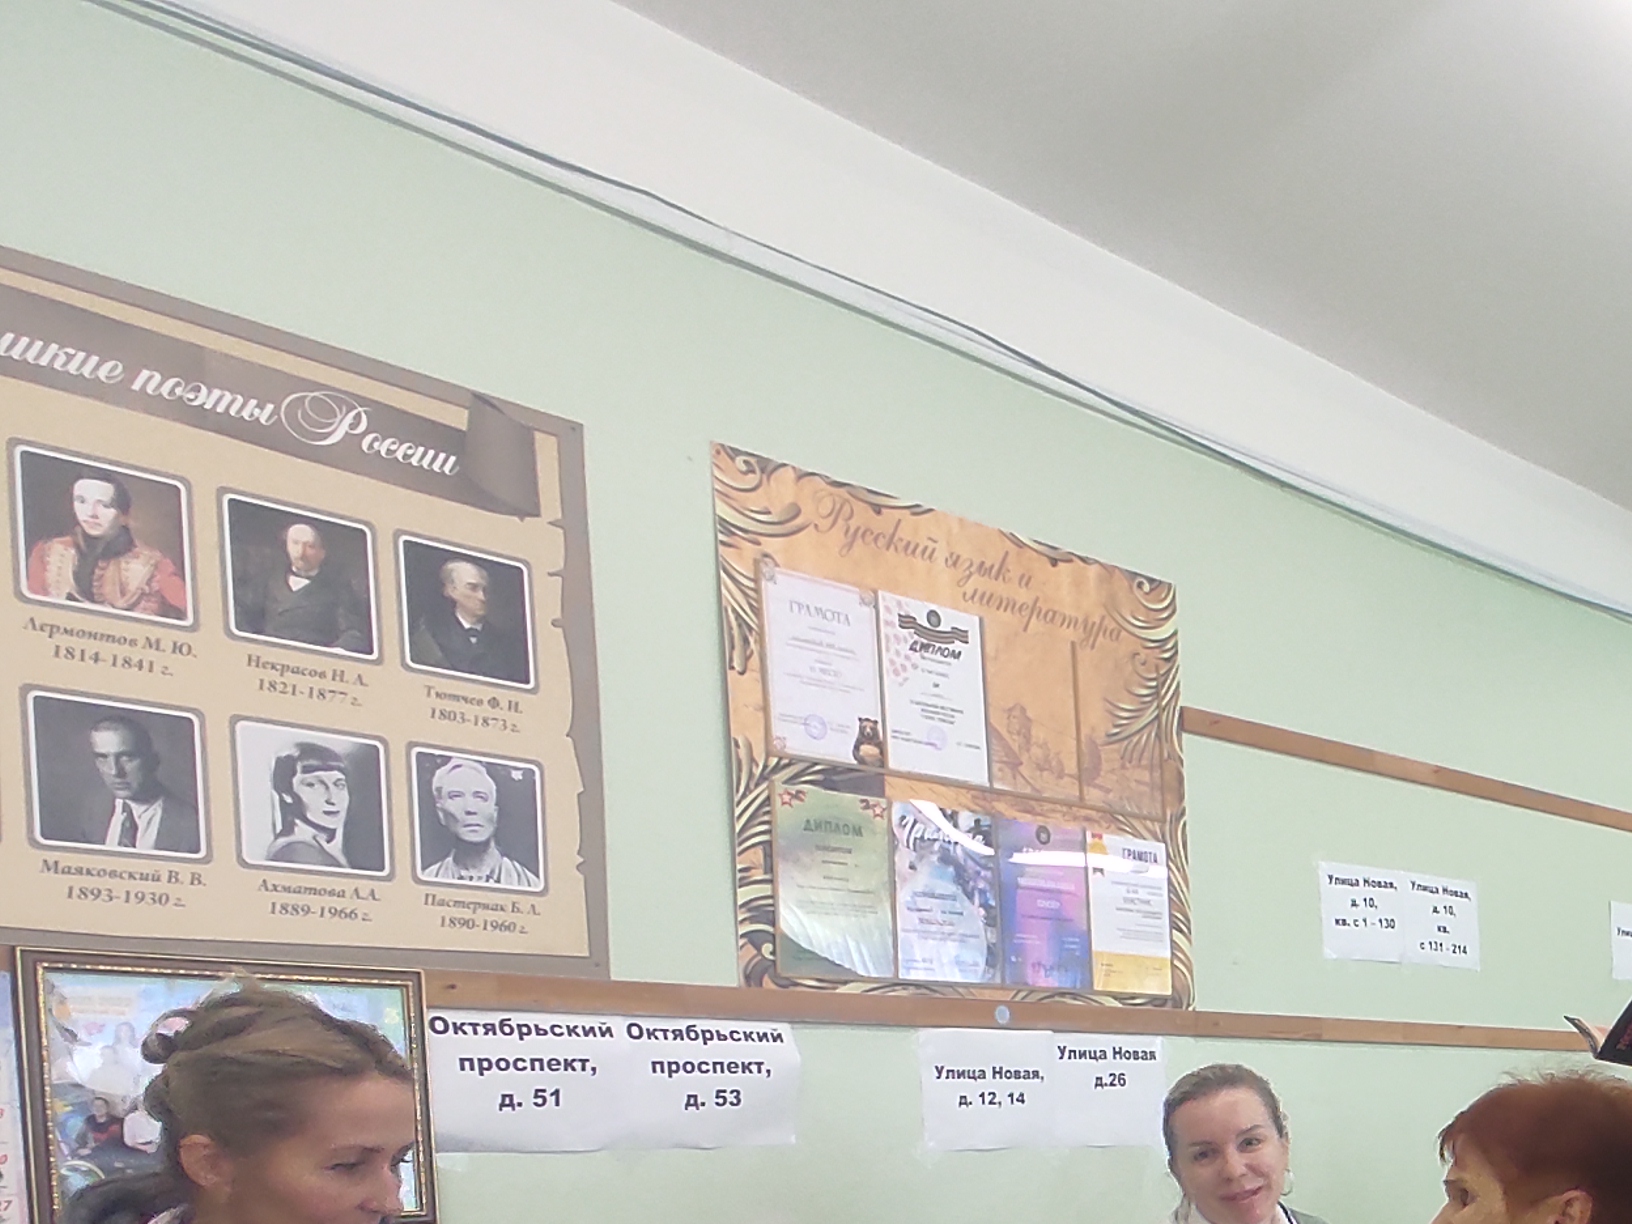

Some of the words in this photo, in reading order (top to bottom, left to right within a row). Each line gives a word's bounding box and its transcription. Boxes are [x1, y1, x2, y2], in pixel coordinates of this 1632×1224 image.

[131, 369, 278, 426] поэты
[280, 391, 460, 475] России
[812, 489, 938, 563] Русский
[945, 550, 1011, 587] язык
[1018, 573, 1032, 589] и
[789, 600, 851, 627] ГРАМОТА
[962, 588, 1122, 651] литература
[22, 617, 138, 647] Лермонтов
[141, 636, 166, 653] М.
[171, 640, 197, 658] Ю.
[52, 644, 154, 673] 1814-1841
[909, 640, 962, 659] ДИПЛОМ
[246, 653, 327, 679] Некрасов
[331, 669, 349, 683] Н.
[352, 673, 369, 687] А.
[259, 678, 349, 703] 1821-1877
[424, 684, 484, 707] Тютчев
[487, 696, 503, 711] Ф.
[430, 707, 508, 731] 1803-1873
[803, 819, 864, 837] ДИПЛОМ
[1122, 848, 1158, 864] ГРАМОТА
[39, 859, 162, 883] Маяковский
[167, 869, 184, 885] В.
[190, 872, 207, 887] В.
[1327, 874, 1360, 887] Улица
[1363, 877, 1397, 891] Новая,
[67, 885, 169, 907] 1893-1930
[258, 879, 346, 899] Ахматова
[1410, 880, 1439, 894] Улица
[1442, 885, 1471, 901] Новая,
[269, 901, 359, 920] 1889-1966
[423, 892, 507, 914] Пастернак
[510, 901, 524, 914] Б.
[527, 903, 541, 916] А.
[1363, 897, 1378, 910] 10,
[1443, 905, 1456, 917] 10,
[440, 915, 517, 933] 1890-1960
[1335, 918, 1351, 927] кв.
[1353, 919, 1359, 927] с
[1362, 917, 1367, 927] 1
[1378, 917, 1396, 929] 130
[1437, 925, 1450, 934] кв.
[1420, 942, 1425, 950] с
[1428, 941, 1443, 952] 131
[1452, 943, 1468, 955] 214
[428, 1015, 614, 1041] Октябрьский
[626, 1022, 784, 1046] Октябрьский
[1057, 1045, 1107, 1062] Улица
[1112, 1046, 1157, 1061] Новая
[458, 1055, 597, 1077] проспект,
[651, 1059, 772, 1079] проспект,
[934, 1066, 986, 1082] Улица
[992, 1066, 1045, 1083] Новая,
[1094, 1073, 1127, 1089] д.26
[499, 1090, 523, 1111] д.
[533, 1088, 562, 1107] 51
[684, 1092, 706, 1111] д.
[714, 1089, 742, 1107] 53
[958, 1093, 973, 1107] д.
[979, 1091, 1002, 1108] 12,
[1007, 1092, 1026, 1105] 14
